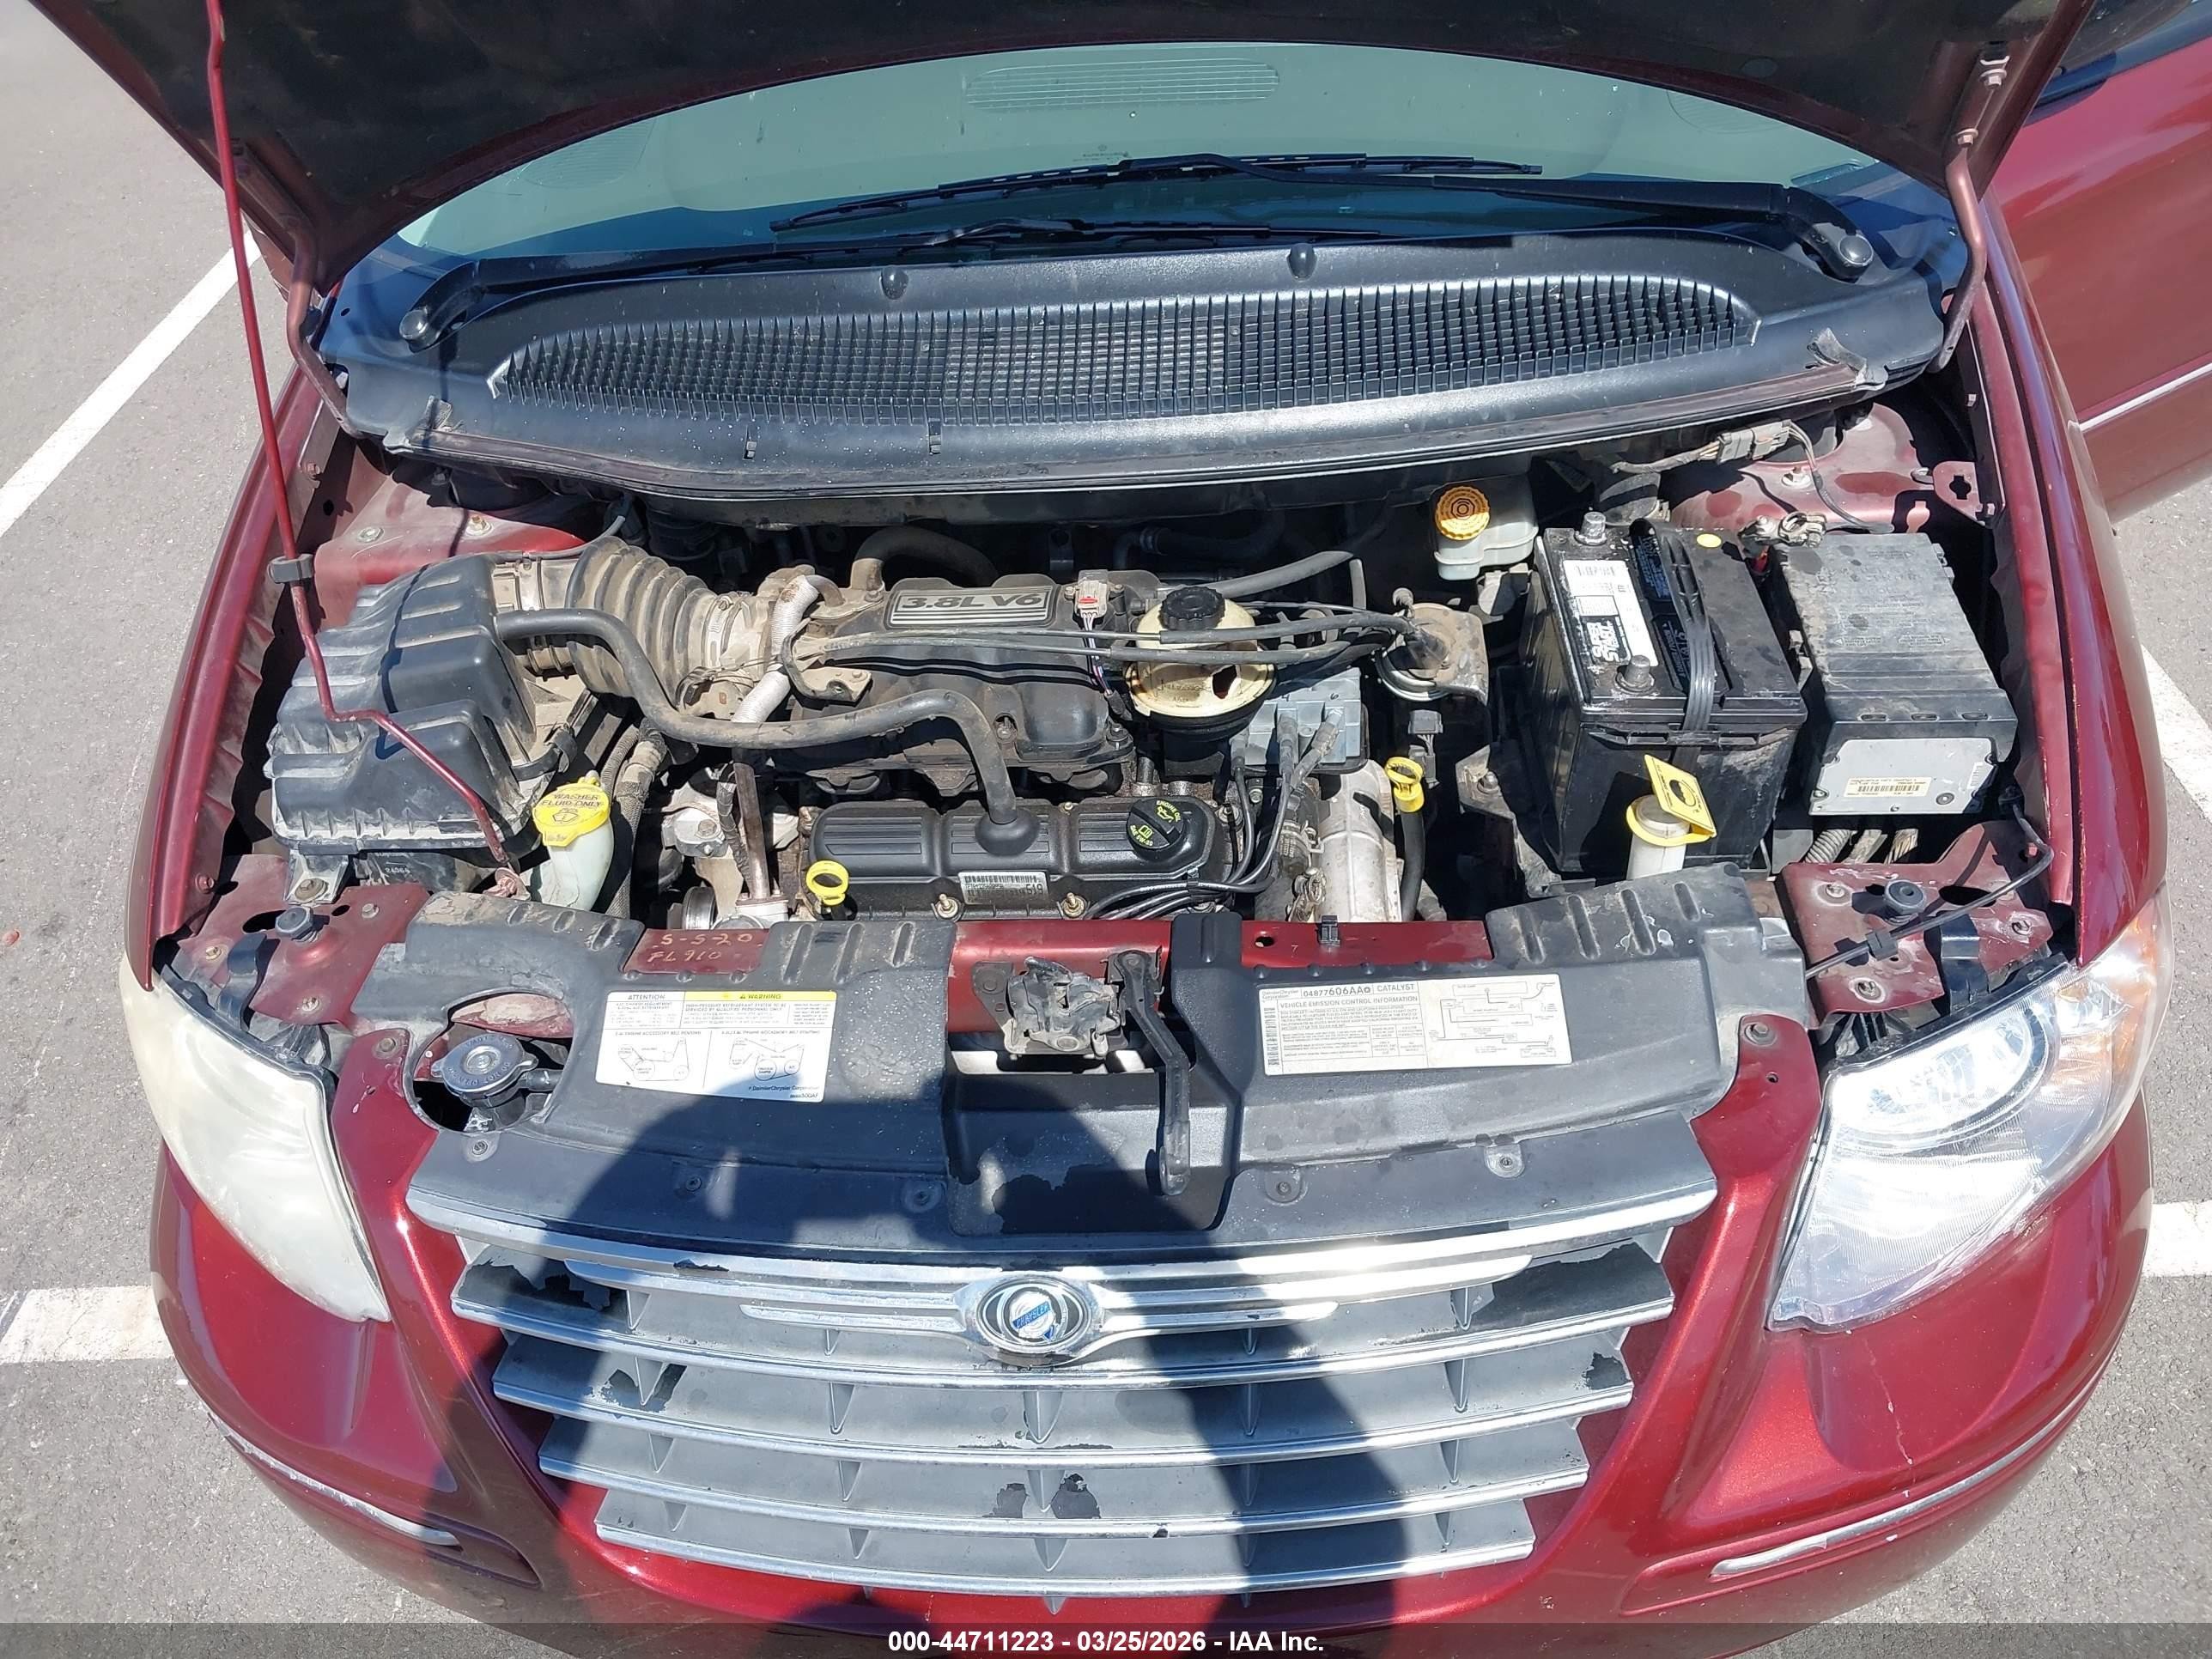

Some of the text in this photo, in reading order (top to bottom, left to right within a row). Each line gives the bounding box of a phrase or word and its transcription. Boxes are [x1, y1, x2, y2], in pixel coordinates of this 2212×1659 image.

[902, 593, 1043, 609] 3.8L V6
[1329, 692, 1340, 701] 6
[574, 799, 603, 807] ONLY
[1376, 983, 1415, 993] CATALYST
[1373, 995, 1418, 1004] INFORMATION
